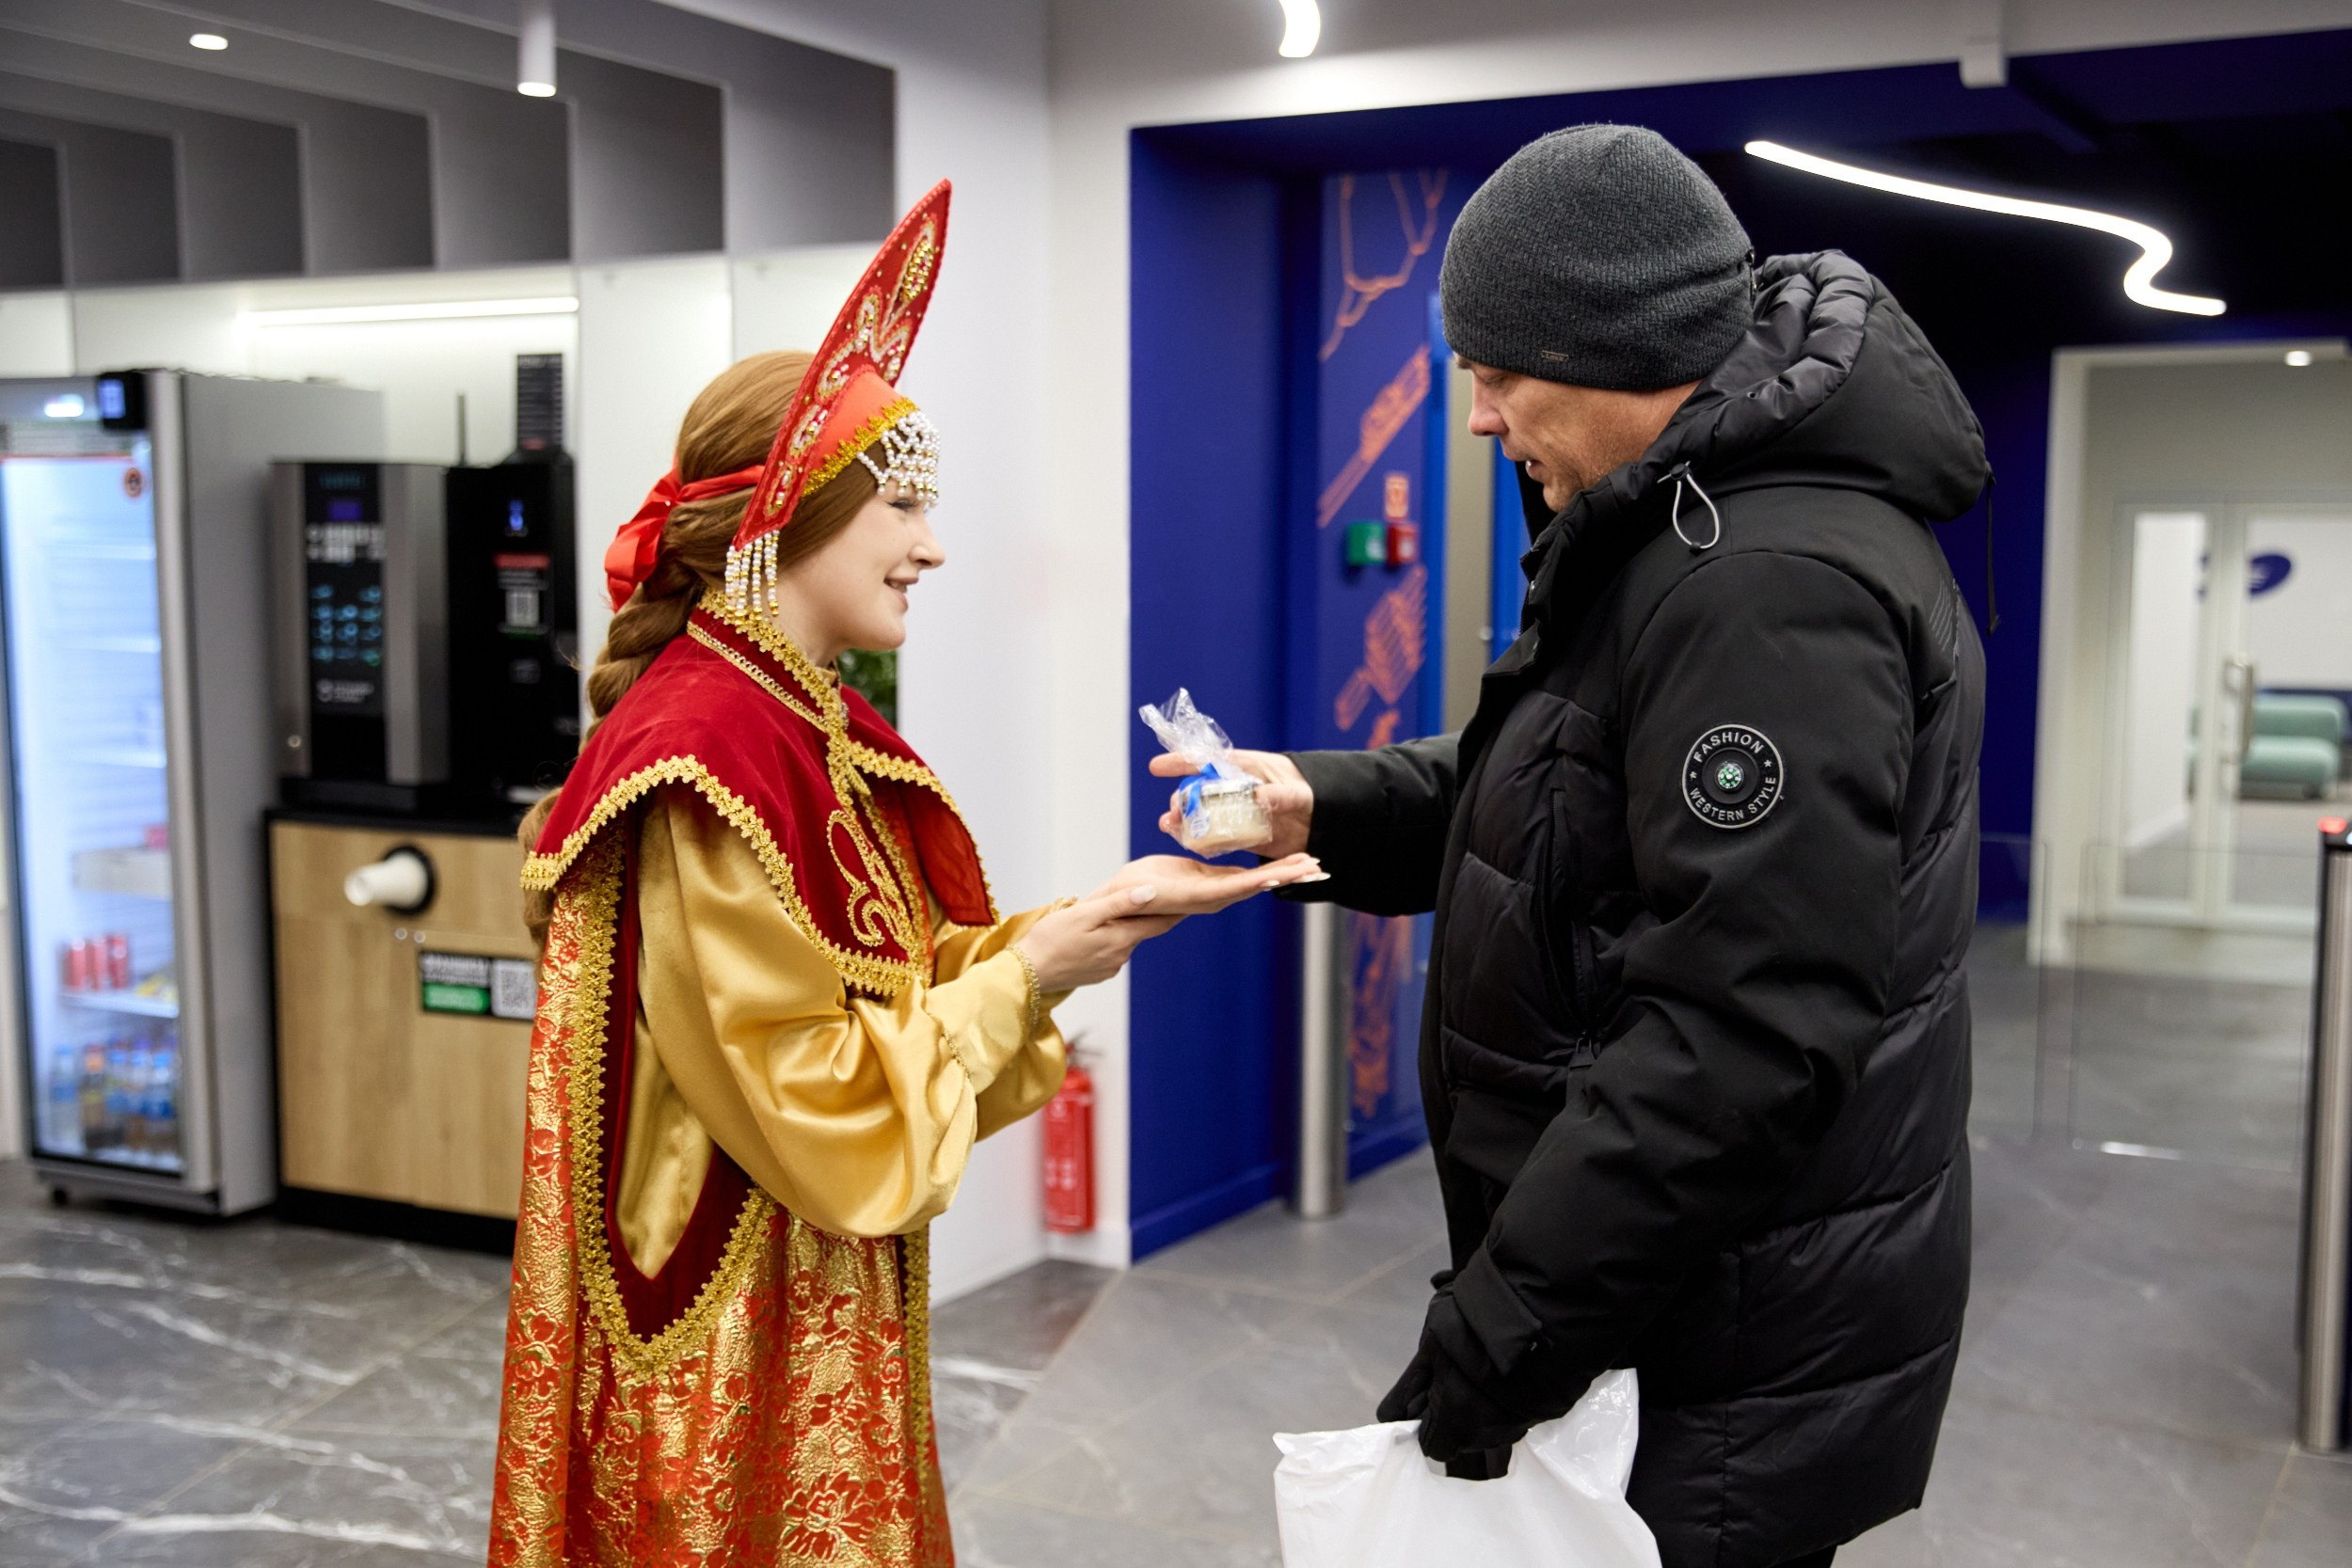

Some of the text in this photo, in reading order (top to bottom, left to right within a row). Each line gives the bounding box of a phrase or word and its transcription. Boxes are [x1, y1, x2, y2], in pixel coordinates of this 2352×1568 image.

[1693, 731, 1765, 763] FASHION
[1690, 776, 1776, 821] WESTERN STYLE
